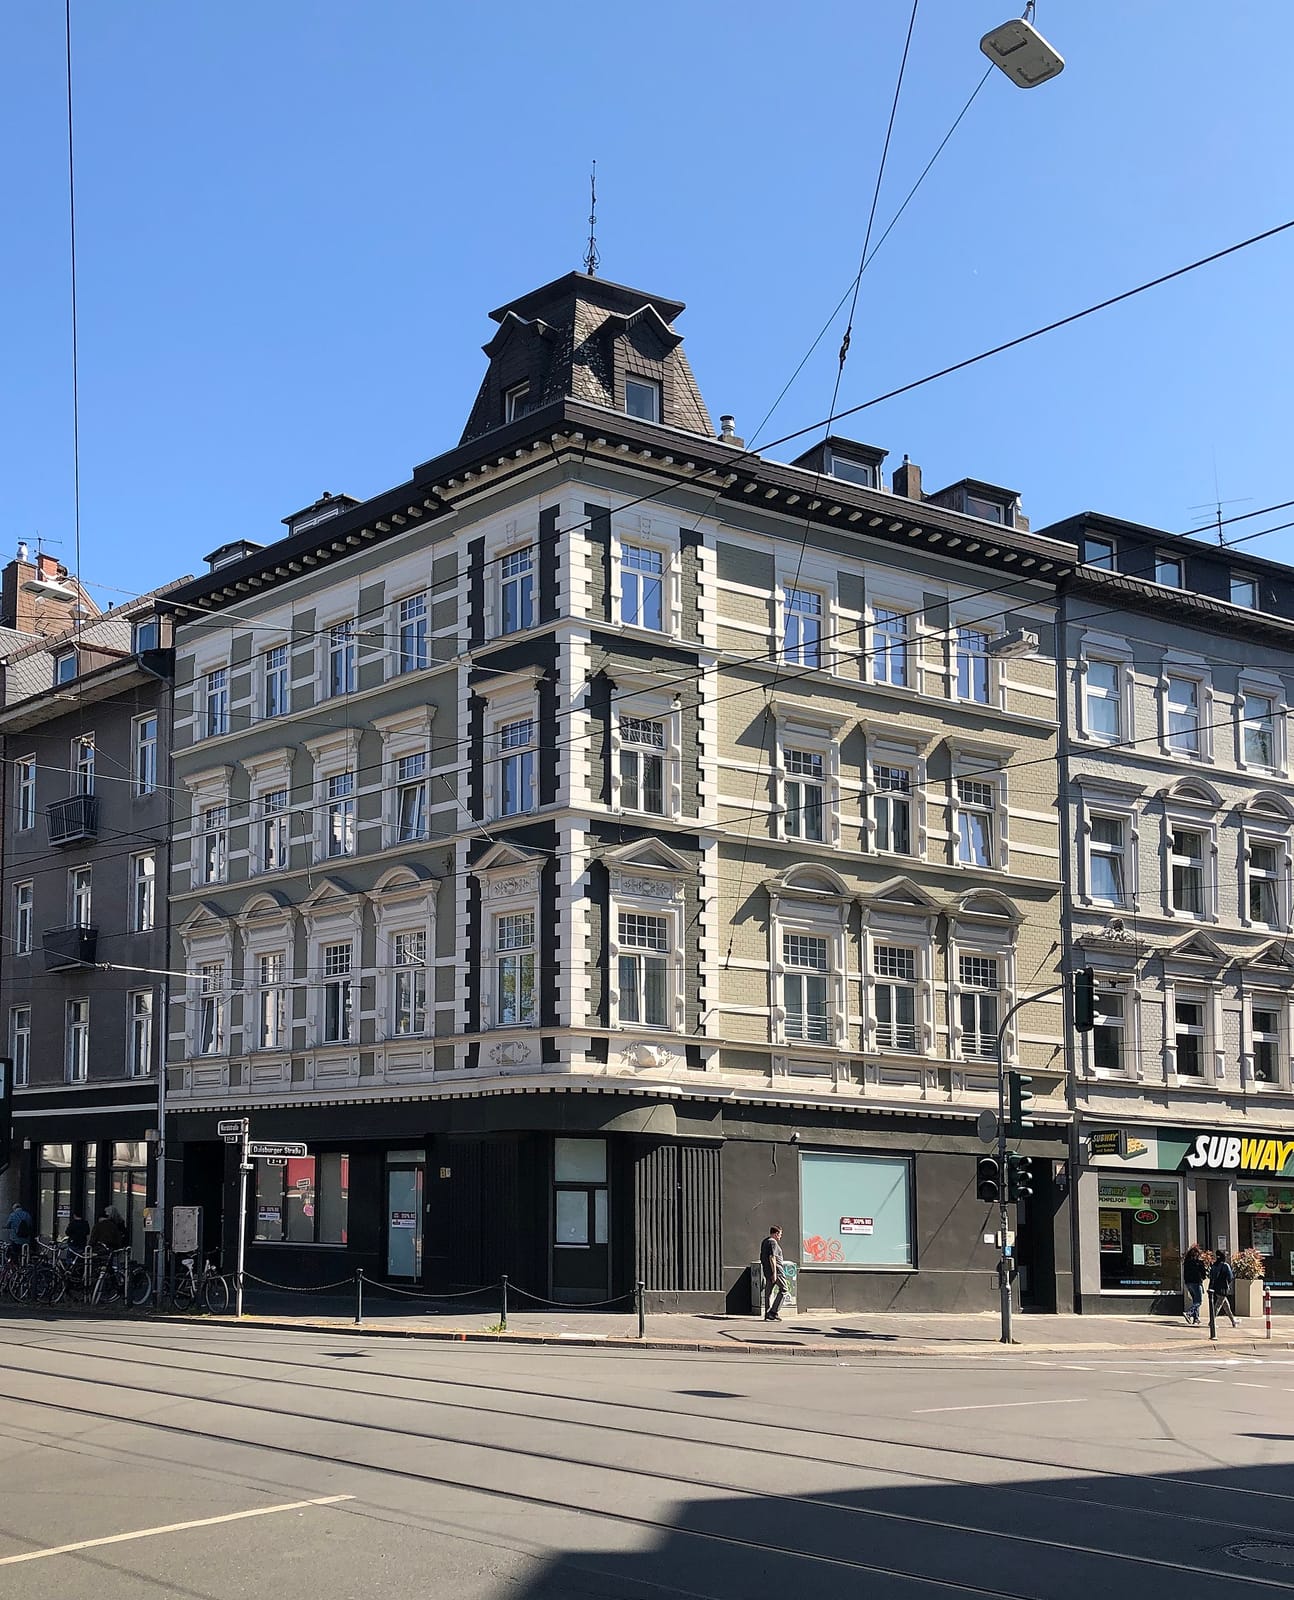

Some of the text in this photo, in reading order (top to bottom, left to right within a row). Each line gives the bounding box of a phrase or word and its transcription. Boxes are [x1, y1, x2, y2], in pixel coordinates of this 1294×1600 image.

[1092, 1133, 1119, 1143] SUBWAY
[253, 1145, 302, 1155] Duisburger Straße
[1184, 1134, 1294, 1171] SUBWAY
